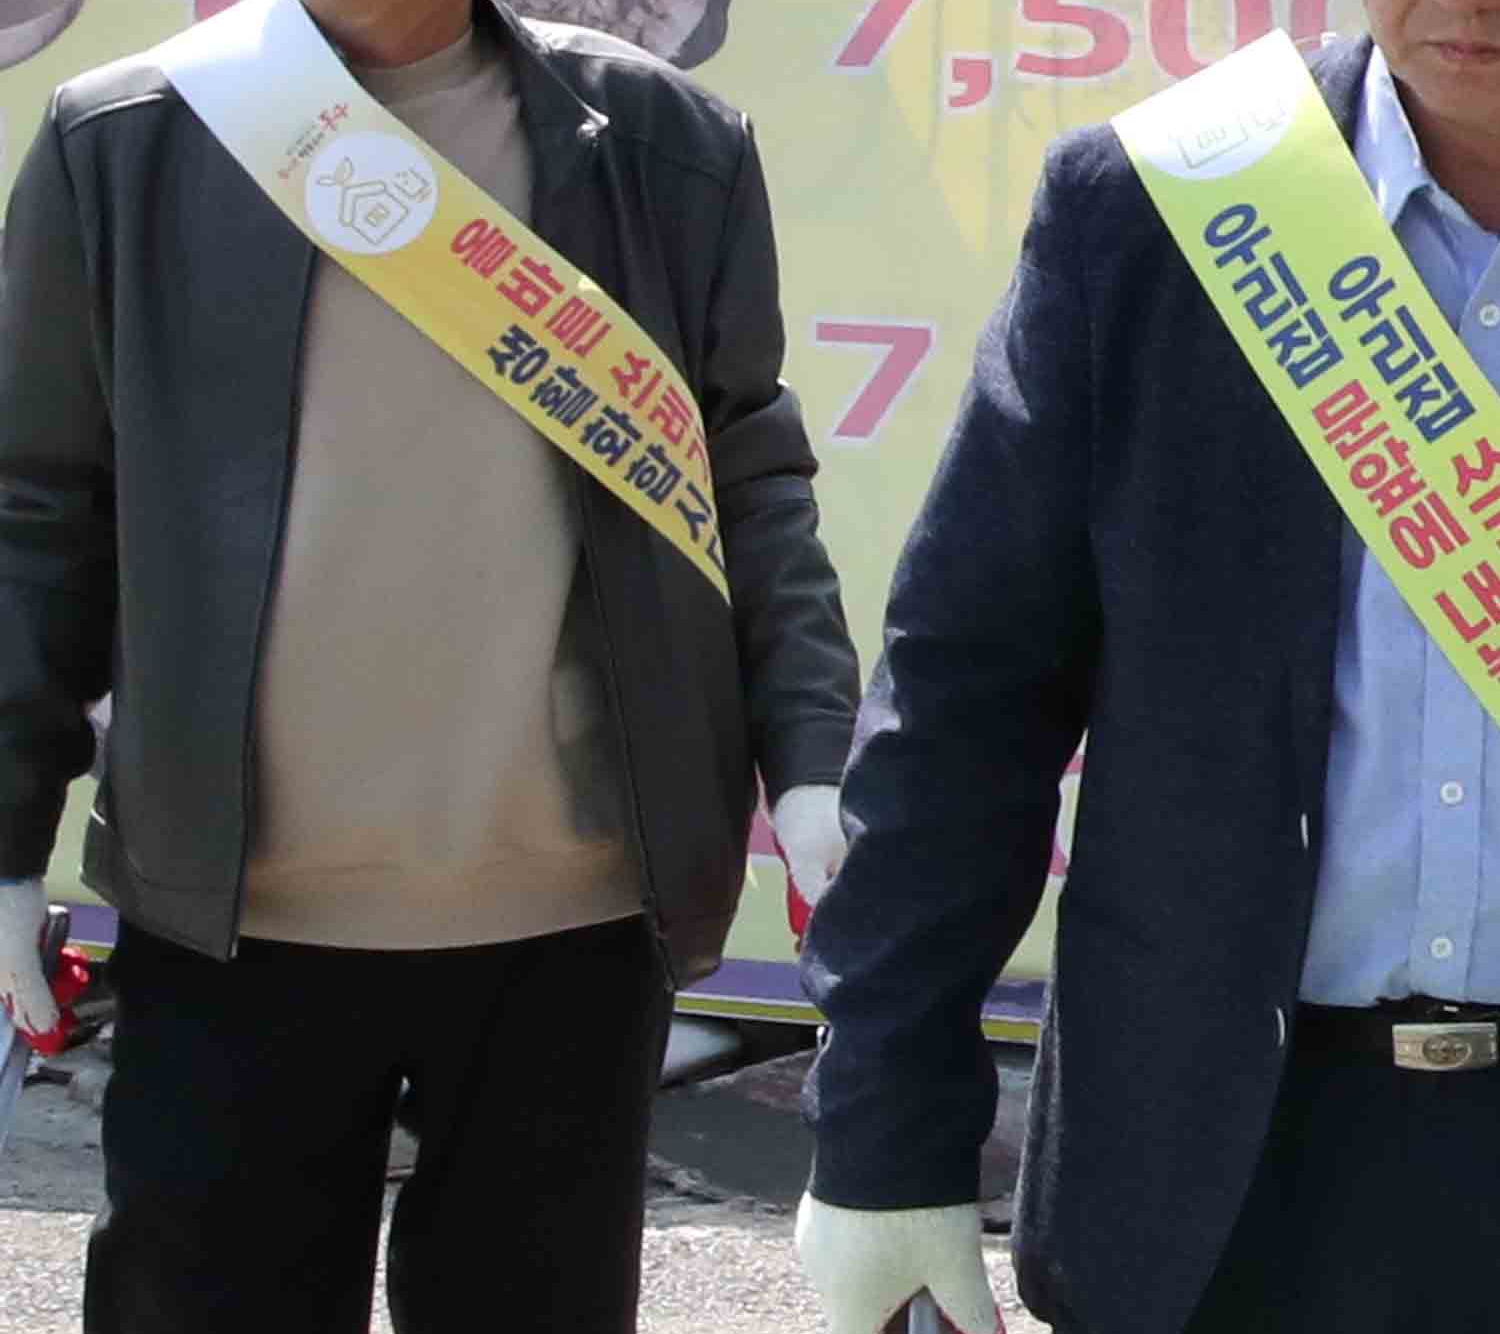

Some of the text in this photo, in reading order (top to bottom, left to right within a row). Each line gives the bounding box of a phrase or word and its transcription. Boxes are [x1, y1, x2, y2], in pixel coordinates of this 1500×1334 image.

[450, 217, 614, 360] 올바른
[1328, 254, 1477, 444] 우리집
[1203, 203, 1345, 392] 우리집
[1311, 378, 1467, 572] 문앞에
